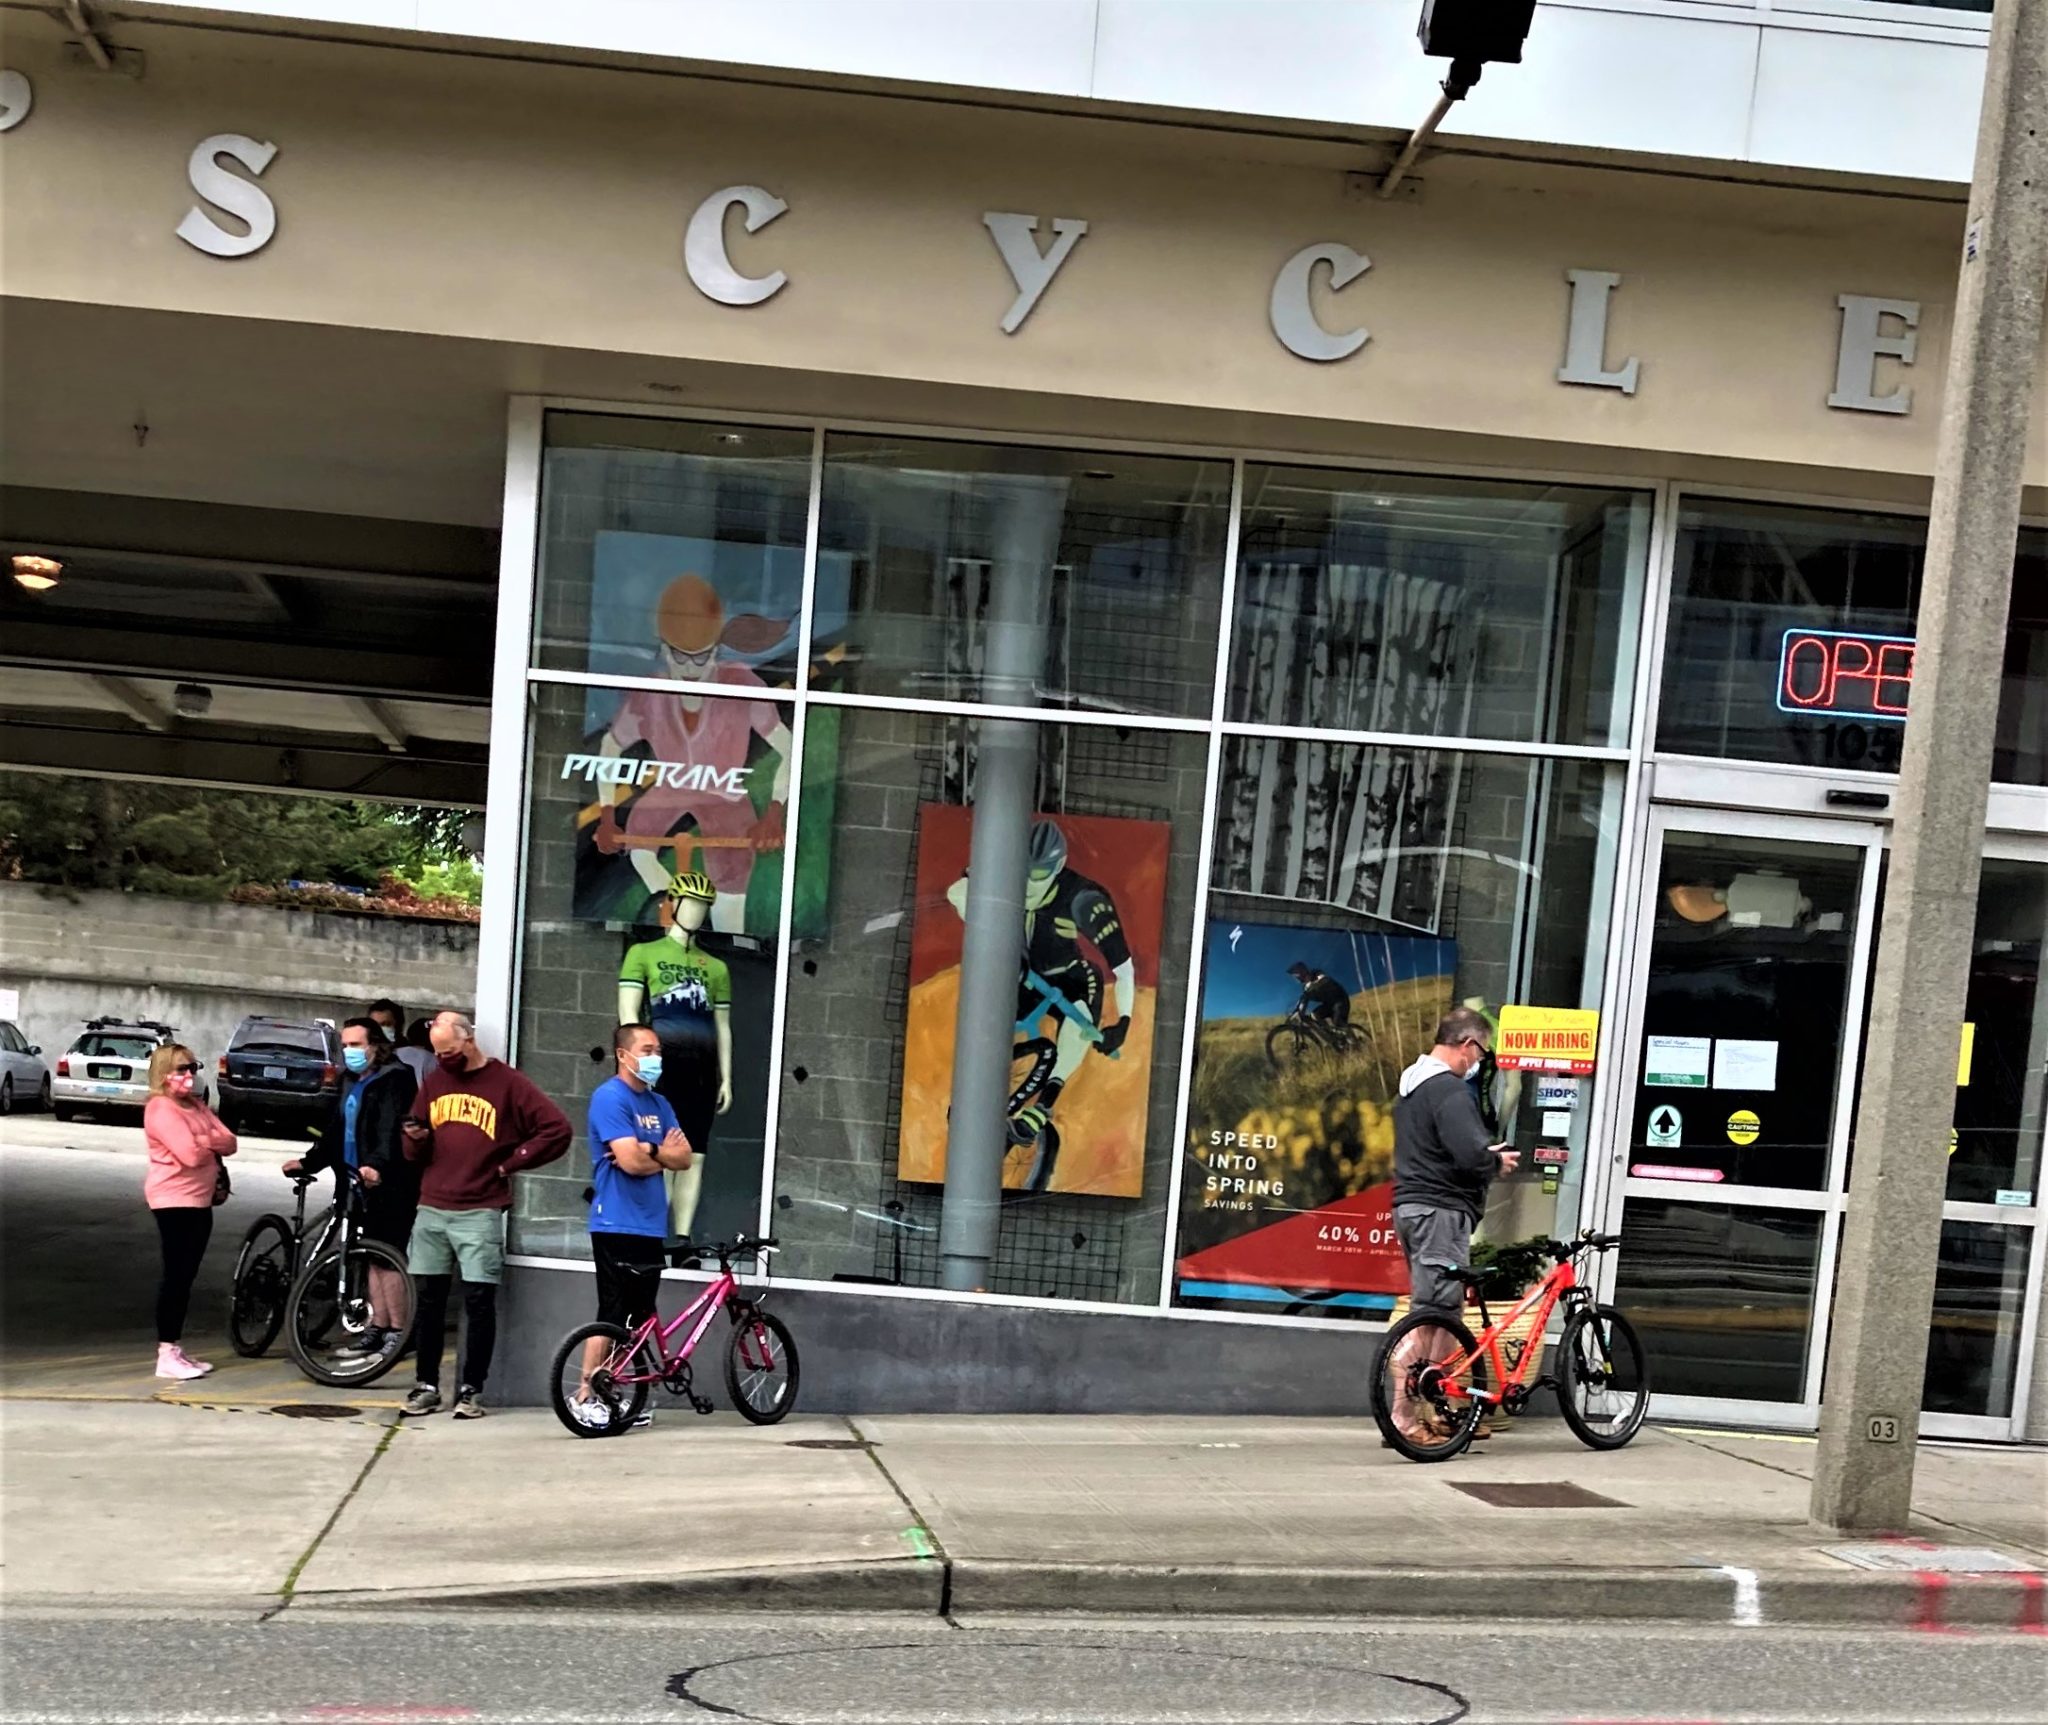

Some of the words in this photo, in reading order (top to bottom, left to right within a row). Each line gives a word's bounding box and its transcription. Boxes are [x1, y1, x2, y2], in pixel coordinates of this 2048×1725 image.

[684, 185, 1921, 416] CYCLE
[1786, 638, 1916, 711] OPE
[561, 754, 754, 794] PROFRAME
[1505, 1032, 1538, 1049] NOW
[1541, 1032, 1589, 1049] HIRING
[1537, 1088, 1578, 1098] SHOPS
[429, 1093, 497, 1140] MINNESOTA
[1210, 1130, 1278, 1149] SPEED
[1209, 1153, 1257, 1171] INTO
[1206, 1175, 1284, 1196] SPRING
[1204, 1198, 1254, 1211] SAVINGS
[1376, 1212, 1392, 1221] UP
[1318, 1225, 1360, 1243] 40%
[1369, 1229, 1402, 1246] OF
[1872, 1421, 1894, 1438] 03
